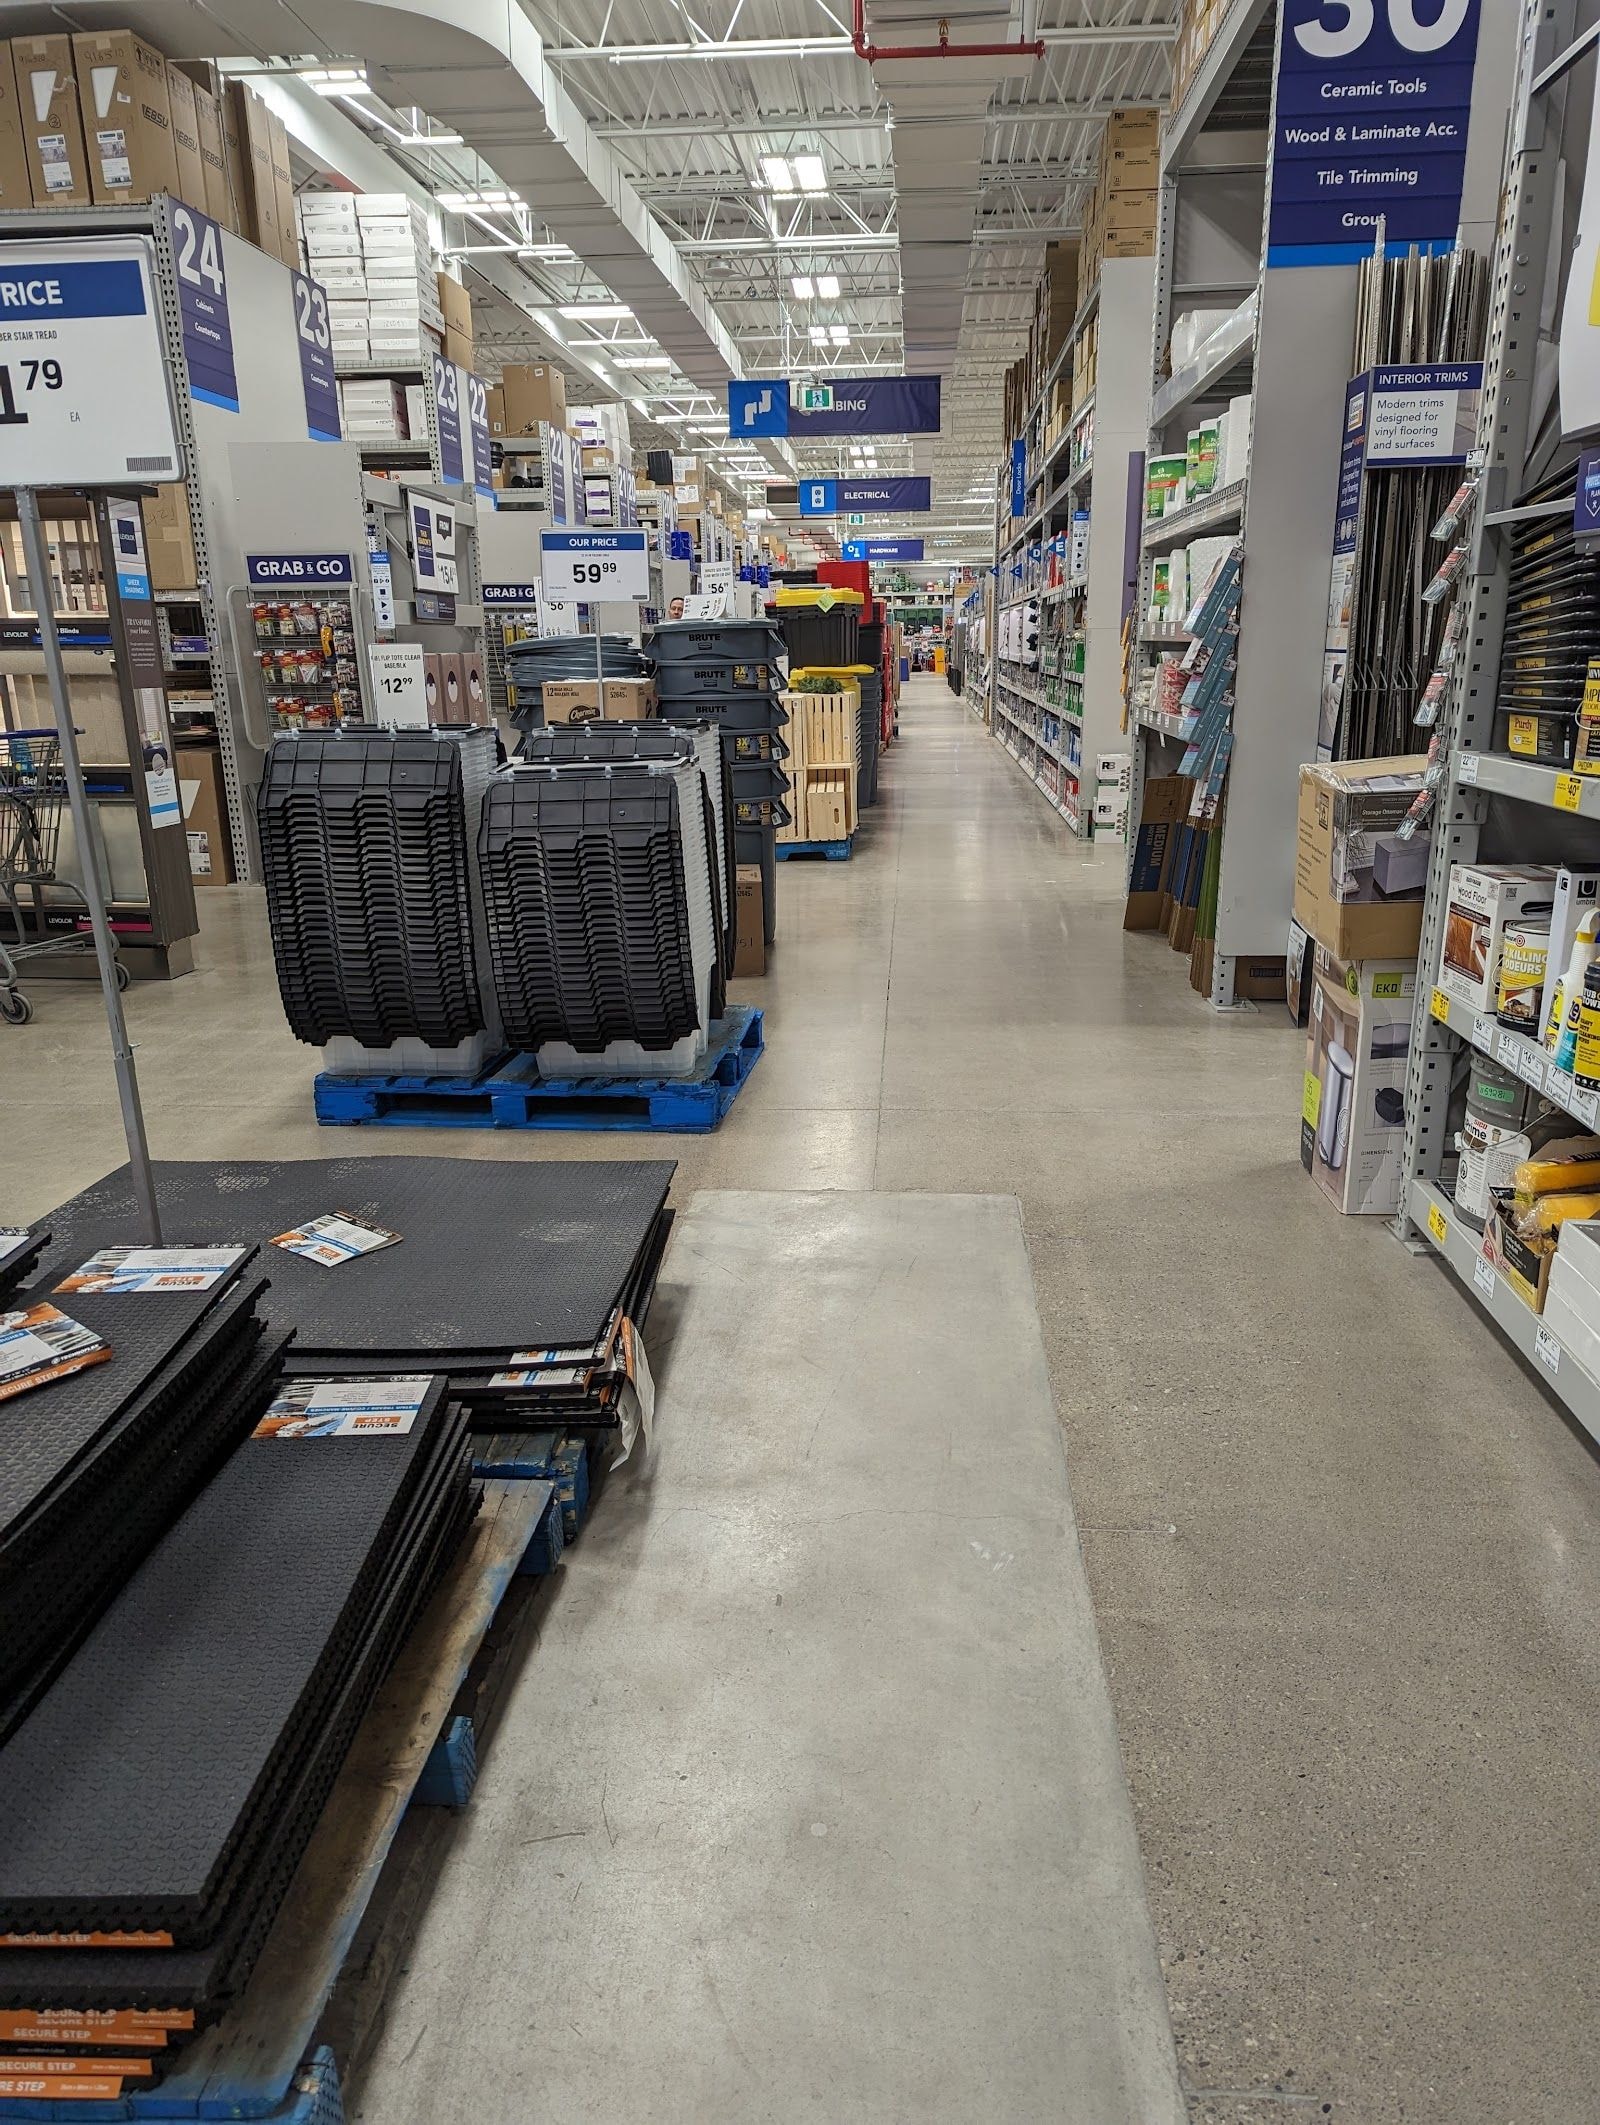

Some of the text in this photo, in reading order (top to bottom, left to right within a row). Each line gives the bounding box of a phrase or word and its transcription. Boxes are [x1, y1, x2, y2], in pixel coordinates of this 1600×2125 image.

[1321, 78, 1427, 98] Ceramic Tools
[1285, 122, 1458, 144] Wood & Laminate Acc.
[1317, 167, 1418, 186] Tile Trimming
[174, 208, 224, 296] 24
[0, 280, 64, 306] RICE
[195, 299, 215, 315] Cabinets
[296, 279, 330, 350] 23
[14, 331, 34, 341] STAIR
[35, 330, 58, 340] TREAD
[194, 322, 221, 341] Countertops
[20, 359, 63, 391] 79
[1379, 371, 1469, 385] INTERIOR TRIMS
[435, 359, 458, 412] 23
[469, 378, 488, 427] 22
[1377, 398, 1444, 409] Modern trims
[70, 411, 81, 422] EA
[1376, 413, 1439, 425] designed for
[1374, 425, 1438, 437] vinyl flooring
[549, 427, 564, 467] 22
[1373, 439, 1435, 450] and surfaces
[844, 491, 890, 500] ELECTRICAL
[569, 538, 618, 547] OUR PRICE
[1056, 542, 1064, 552] E
[1033, 550, 1041, 558] D
[256, 560, 343, 576] GRAB & GO
[572, 562, 617, 584] 59 99
[485, 588, 517, 598] GRAB
[689, 634, 721, 642] BRUTE
[694, 671, 726, 679] BRUTE
[735, 666, 746, 675] 3X
[381, 677, 413, 694] $12 99
[546, 687, 554, 697] 12
[696, 706, 727, 714] BRUTE
[1514, 718, 1532, 732] Purdy
[736, 737, 749, 746] 3X
[737, 804, 749, 812] 3X
[1150, 825, 1168, 867] MEDIUM
[1458, 885, 1488, 904] Wood Floor
[1375, 983, 1398, 994] EKO
[153, 1279, 200, 1287] SECURE
[35, 1370, 60, 1385] STEP
[352, 1422, 398, 1430] SECURE
[13, 2027, 92, 2039] SECURE STEP
[0, 2060, 76, 2071] SECURE STEP
[16, 2080, 46, 2092] STEP
